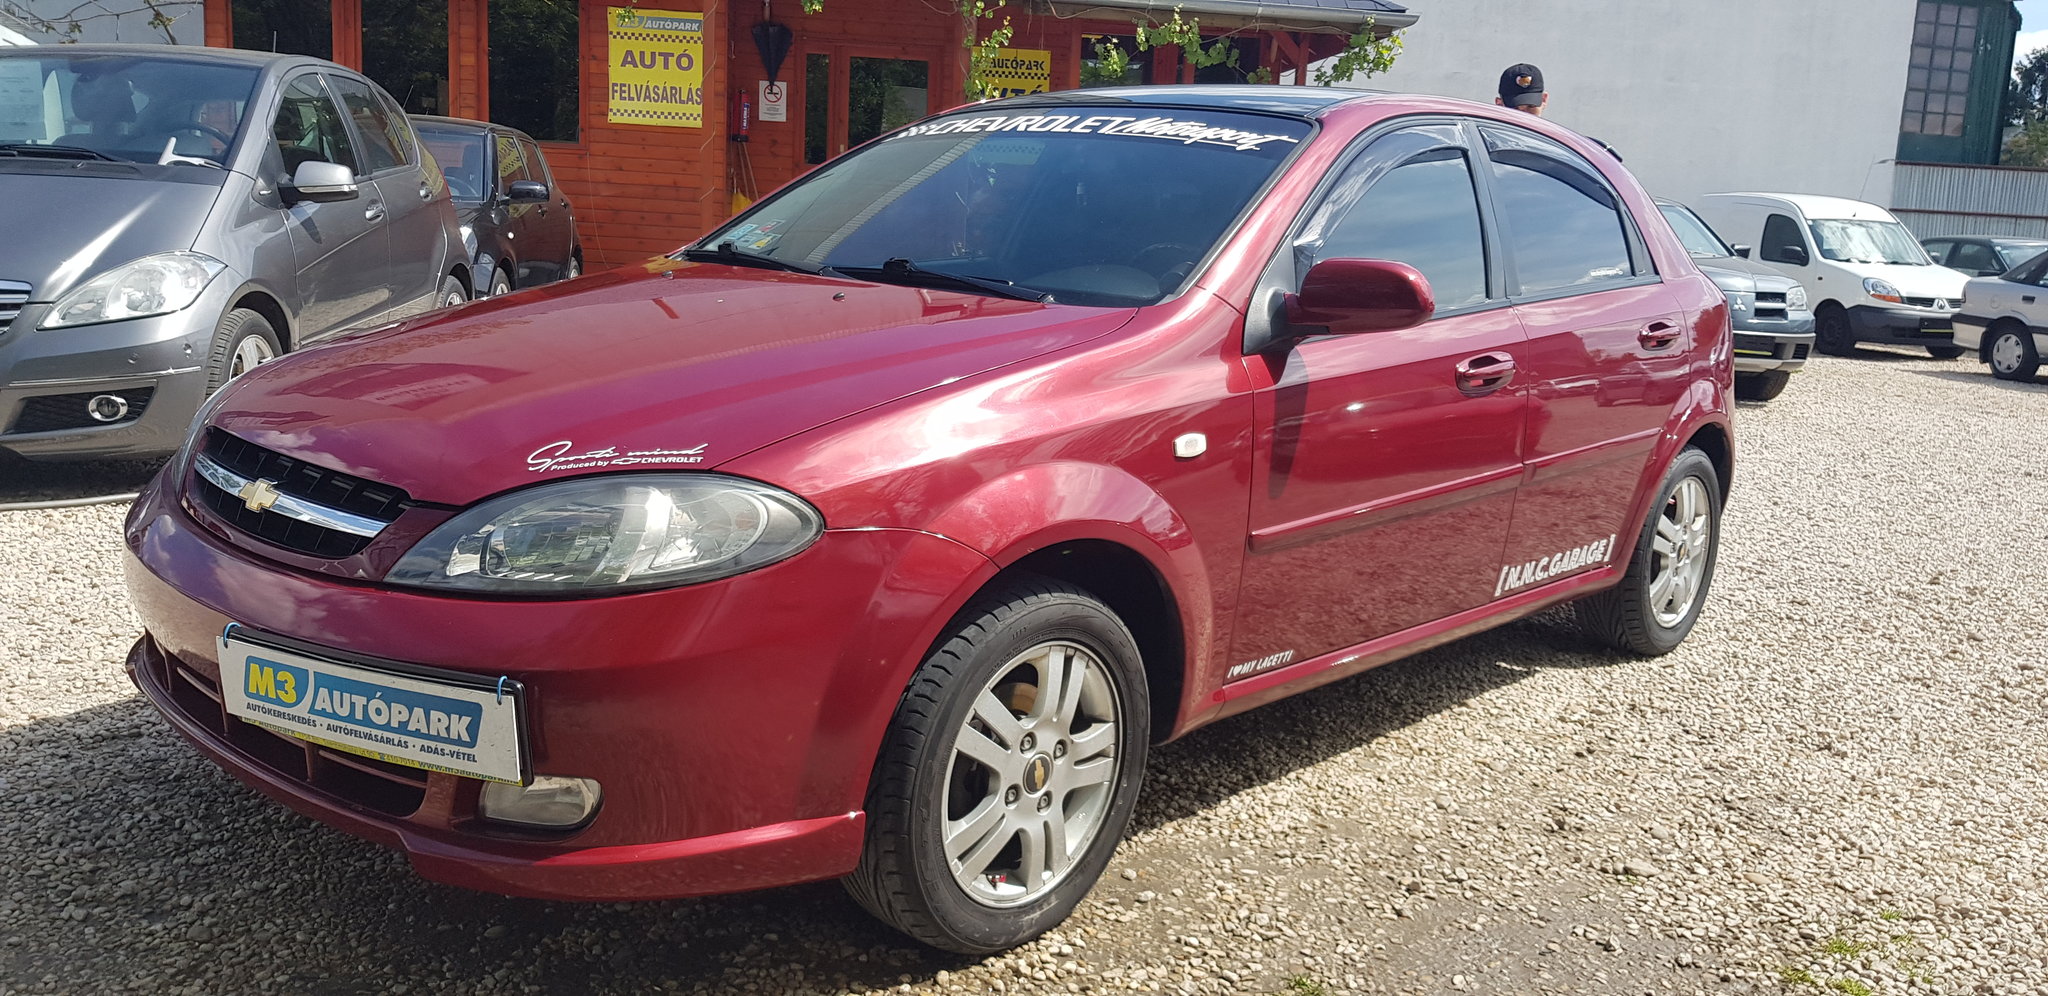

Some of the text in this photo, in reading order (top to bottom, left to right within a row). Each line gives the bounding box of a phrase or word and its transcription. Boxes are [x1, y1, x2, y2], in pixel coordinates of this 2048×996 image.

[644, 19, 700, 31] AUTÓPARK
[620, 49, 694, 71] AUTÓ
[611, 80, 703, 105] FELVÁSÁRLÁS
[924, 115, 1137, 136] CHEVROLET
[628, 443, 709, 456] mind
[550, 461, 596, 471] Produced
[1240, 660, 1257, 674] MY
[1256, 650, 1294, 670] LACETTI
[248, 663, 473, 742] M3 AUTÓPARK
[246, 702, 317, 728] AUTÓKERESKEDÉS
[326, 723, 409, 749] AUTÓFELVÁSÁRLÁS
[419, 744, 478, 763] ADÁS-VÉTEL
